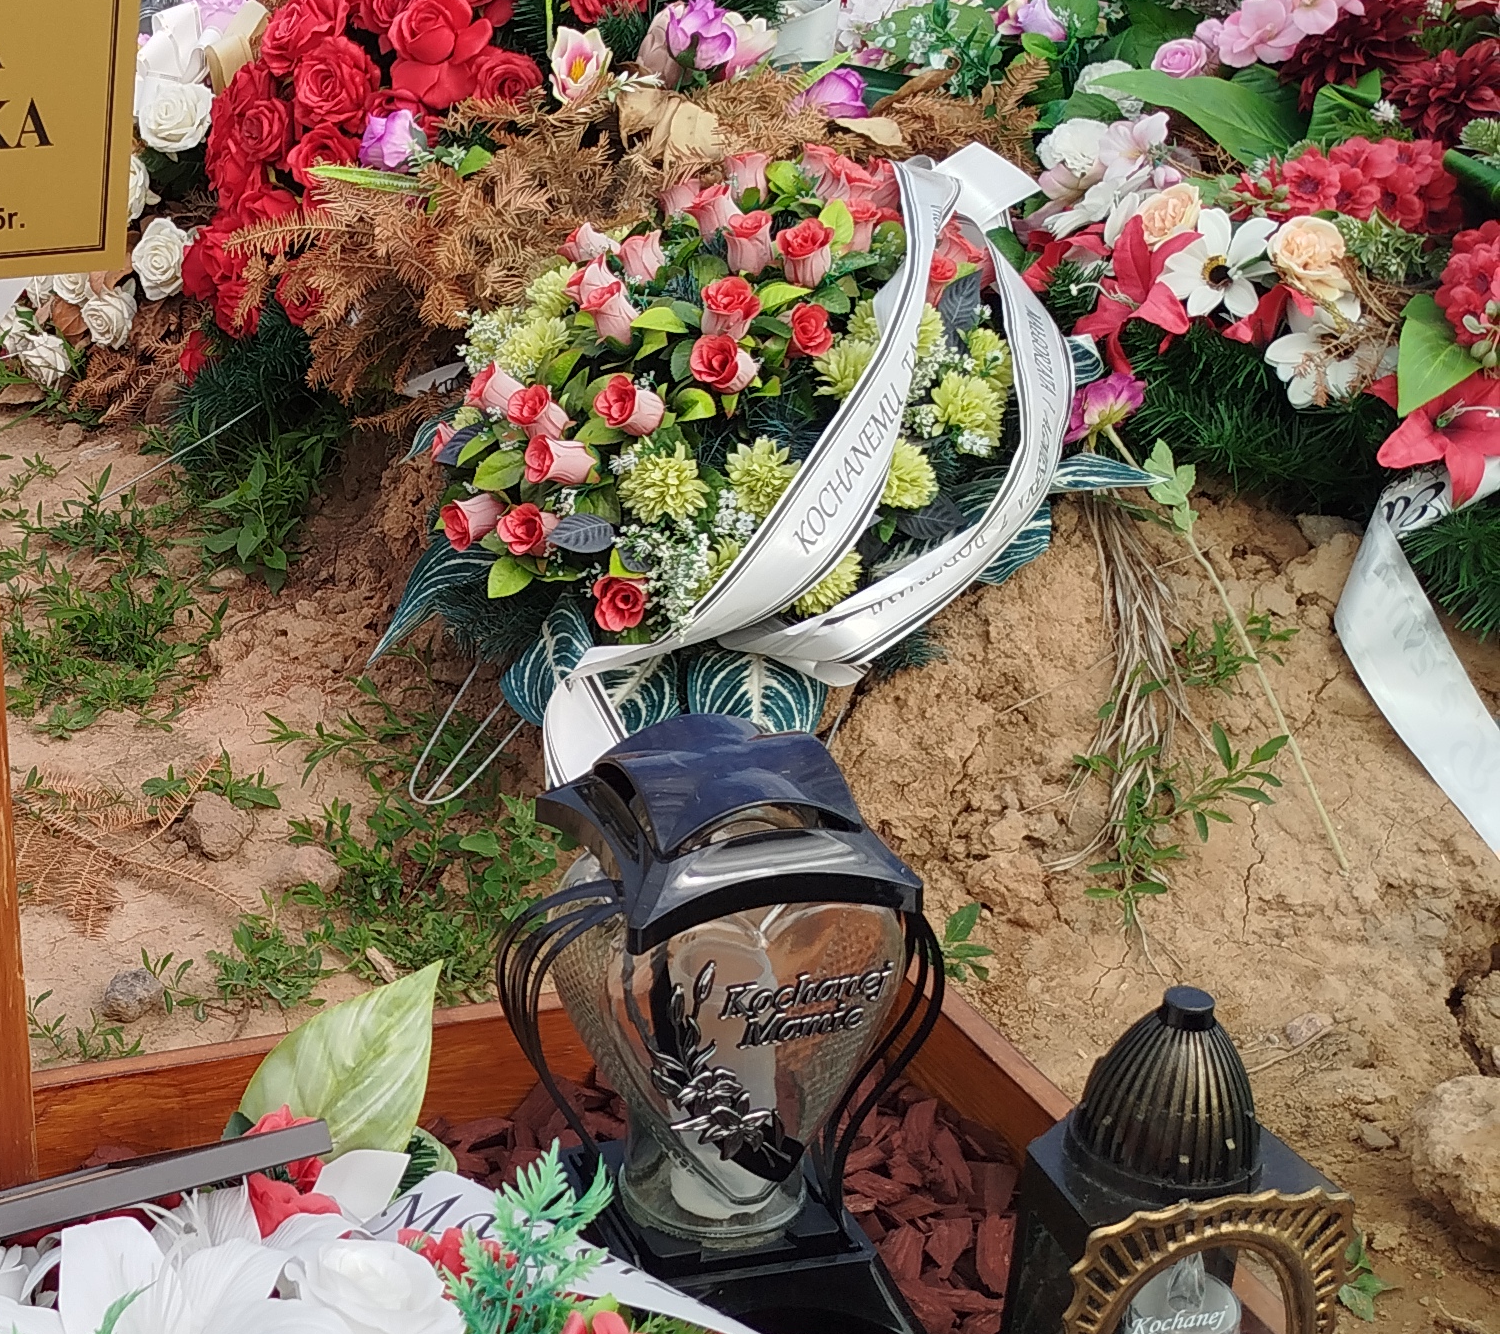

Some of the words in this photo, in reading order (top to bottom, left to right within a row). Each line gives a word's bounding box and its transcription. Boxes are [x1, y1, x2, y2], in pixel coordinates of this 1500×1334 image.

[793, 381, 904, 555] KOCHANEMU
[718, 959, 896, 1021] Kochanej
[736, 998, 865, 1050] Mamie
